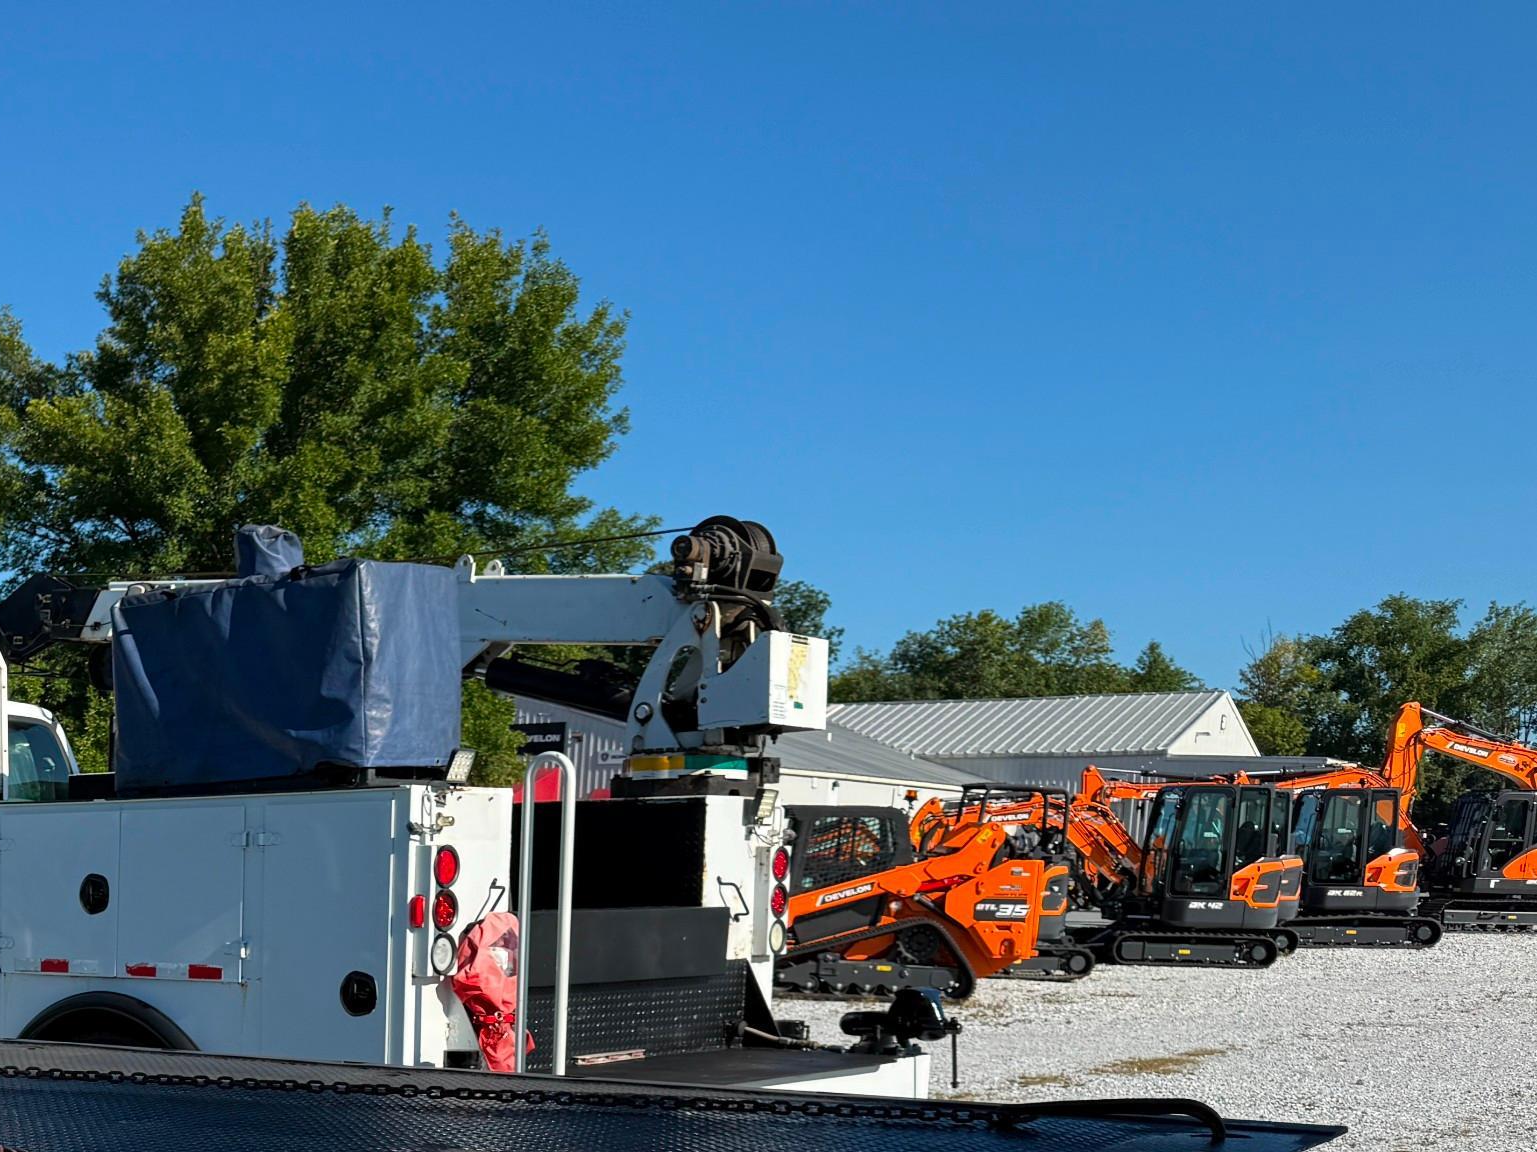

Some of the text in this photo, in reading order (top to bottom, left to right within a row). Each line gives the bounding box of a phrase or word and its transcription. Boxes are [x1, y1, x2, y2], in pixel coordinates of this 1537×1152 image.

[527, 734, 561, 743] VELON
[1453, 743, 1489, 758] DEVELON
[990, 812, 1029, 822] DEVELON
[824, 884, 872, 902] DEVELON
[995, 903, 1030, 918] 35
